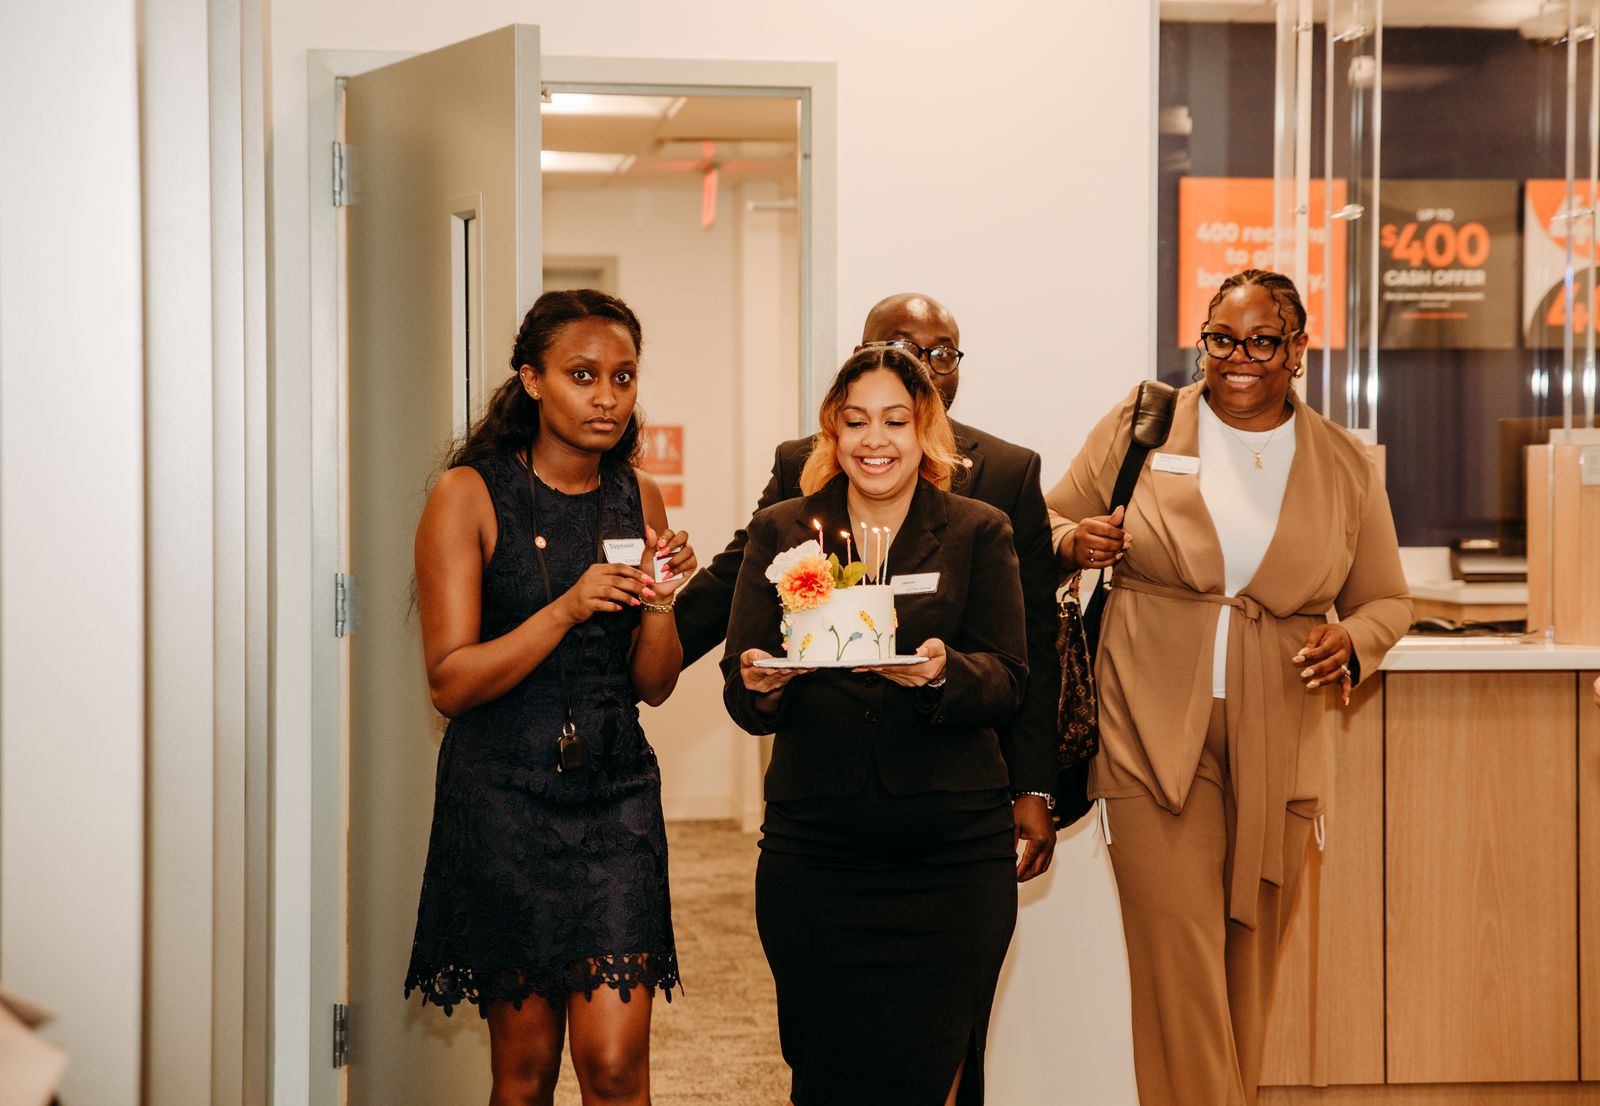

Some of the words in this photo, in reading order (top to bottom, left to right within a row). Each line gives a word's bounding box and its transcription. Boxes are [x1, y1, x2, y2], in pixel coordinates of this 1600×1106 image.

[1417, 208, 1435, 222] UP
[1437, 208, 1454, 222] TO
[1549, 194, 1600, 244] 4
[1196, 222, 1239, 242] 400
[1381, 222, 1490, 268] $400
[1225, 247, 1249, 266] to
[1383, 270, 1431, 286] CASH
[1433, 270, 1485, 286] OFFER
[1547, 281, 1600, 333] 4
